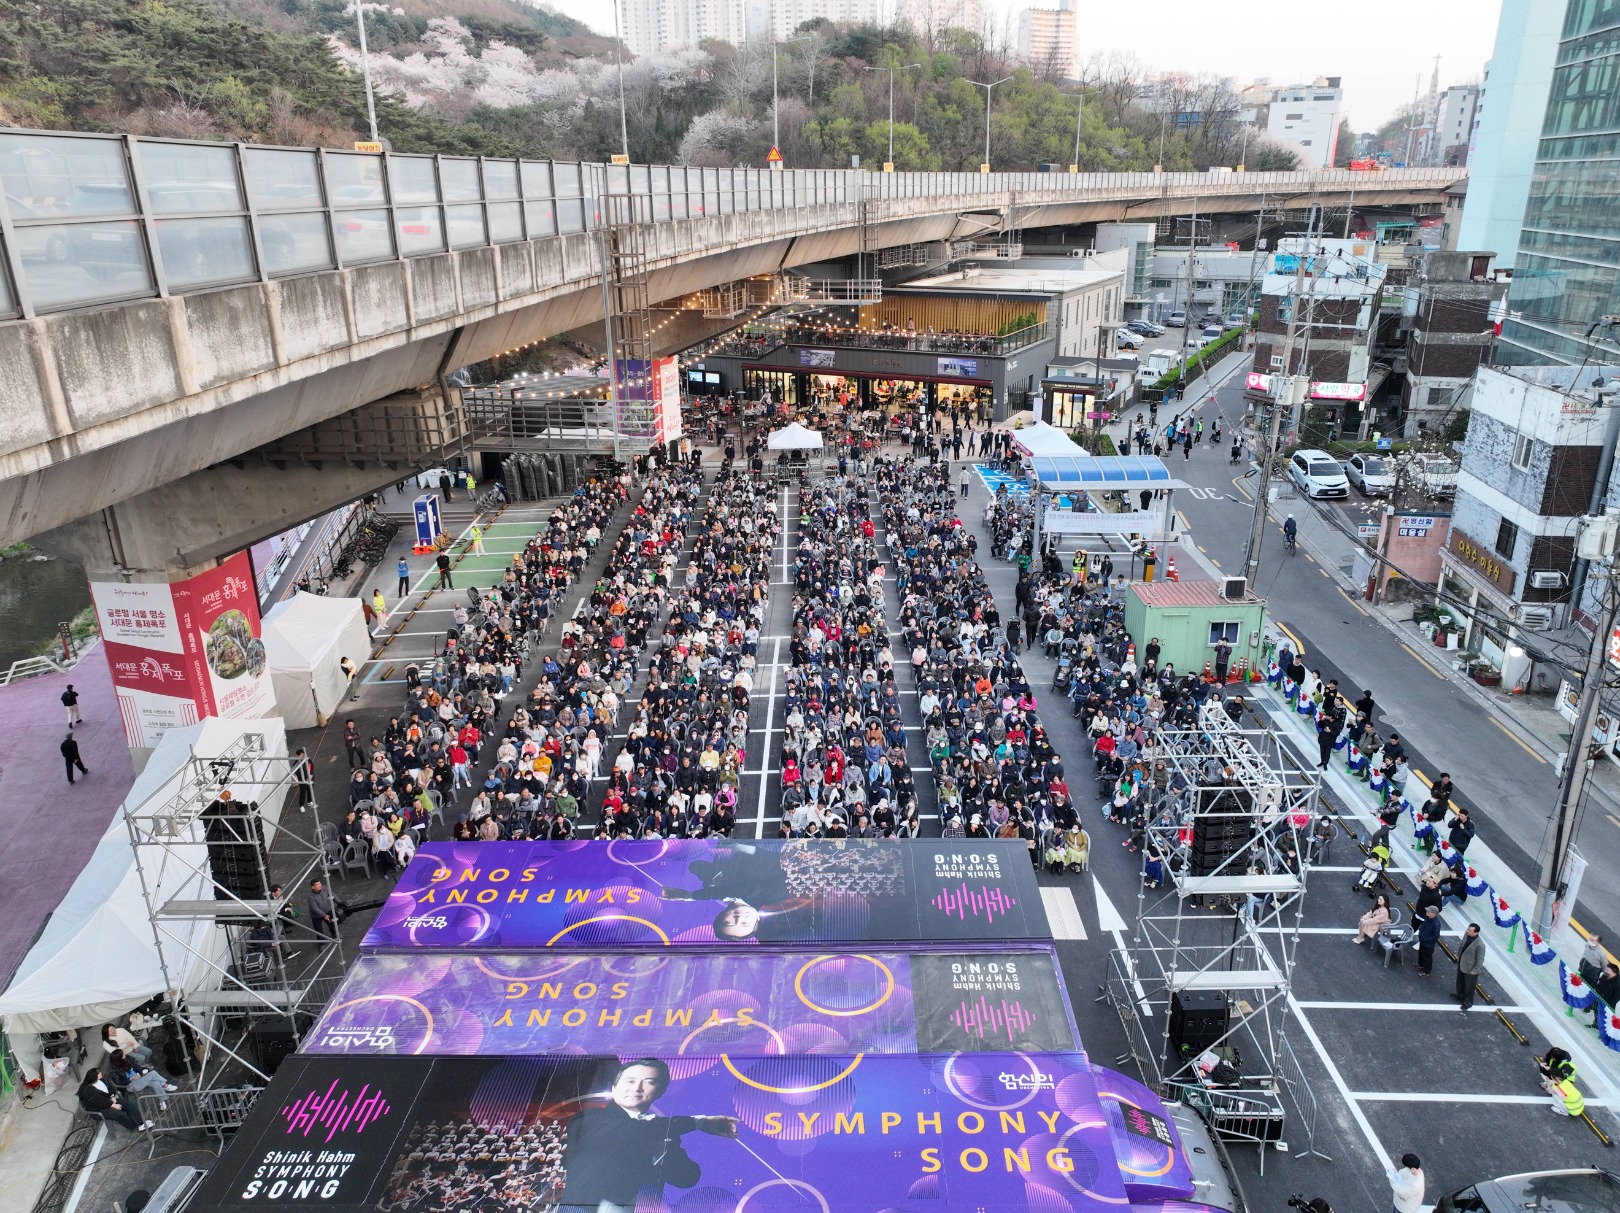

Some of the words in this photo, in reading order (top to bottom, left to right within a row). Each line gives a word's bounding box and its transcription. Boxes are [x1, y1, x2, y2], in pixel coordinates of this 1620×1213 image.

[1400, 528, 1426, 537] 미용실
[107, 608, 130, 617] 글로벌
[132, 610, 147, 618] 서울
[149, 610, 166, 619] 명소
[116, 662, 137, 671] 서대문
[432, 867, 538, 882] SONG
[418, 888, 641, 903] SYMPHONY
[953, 974, 1019, 982] SYMPHONY
[506, 982, 629, 999] SONG
[953, 982, 982, 991] Hahm
[985, 982, 1021, 991] Shinik
[494, 1008, 754, 1027] SYMPHONY
[763, 1111, 1061, 1135] SYMPHONY
[263, 1151, 313, 1163] Shinik
[316, 1150, 356, 1163] Hahm
[921, 1147, 1075, 1173] SONG
[254, 1164, 351, 1178] SYMPHONY
